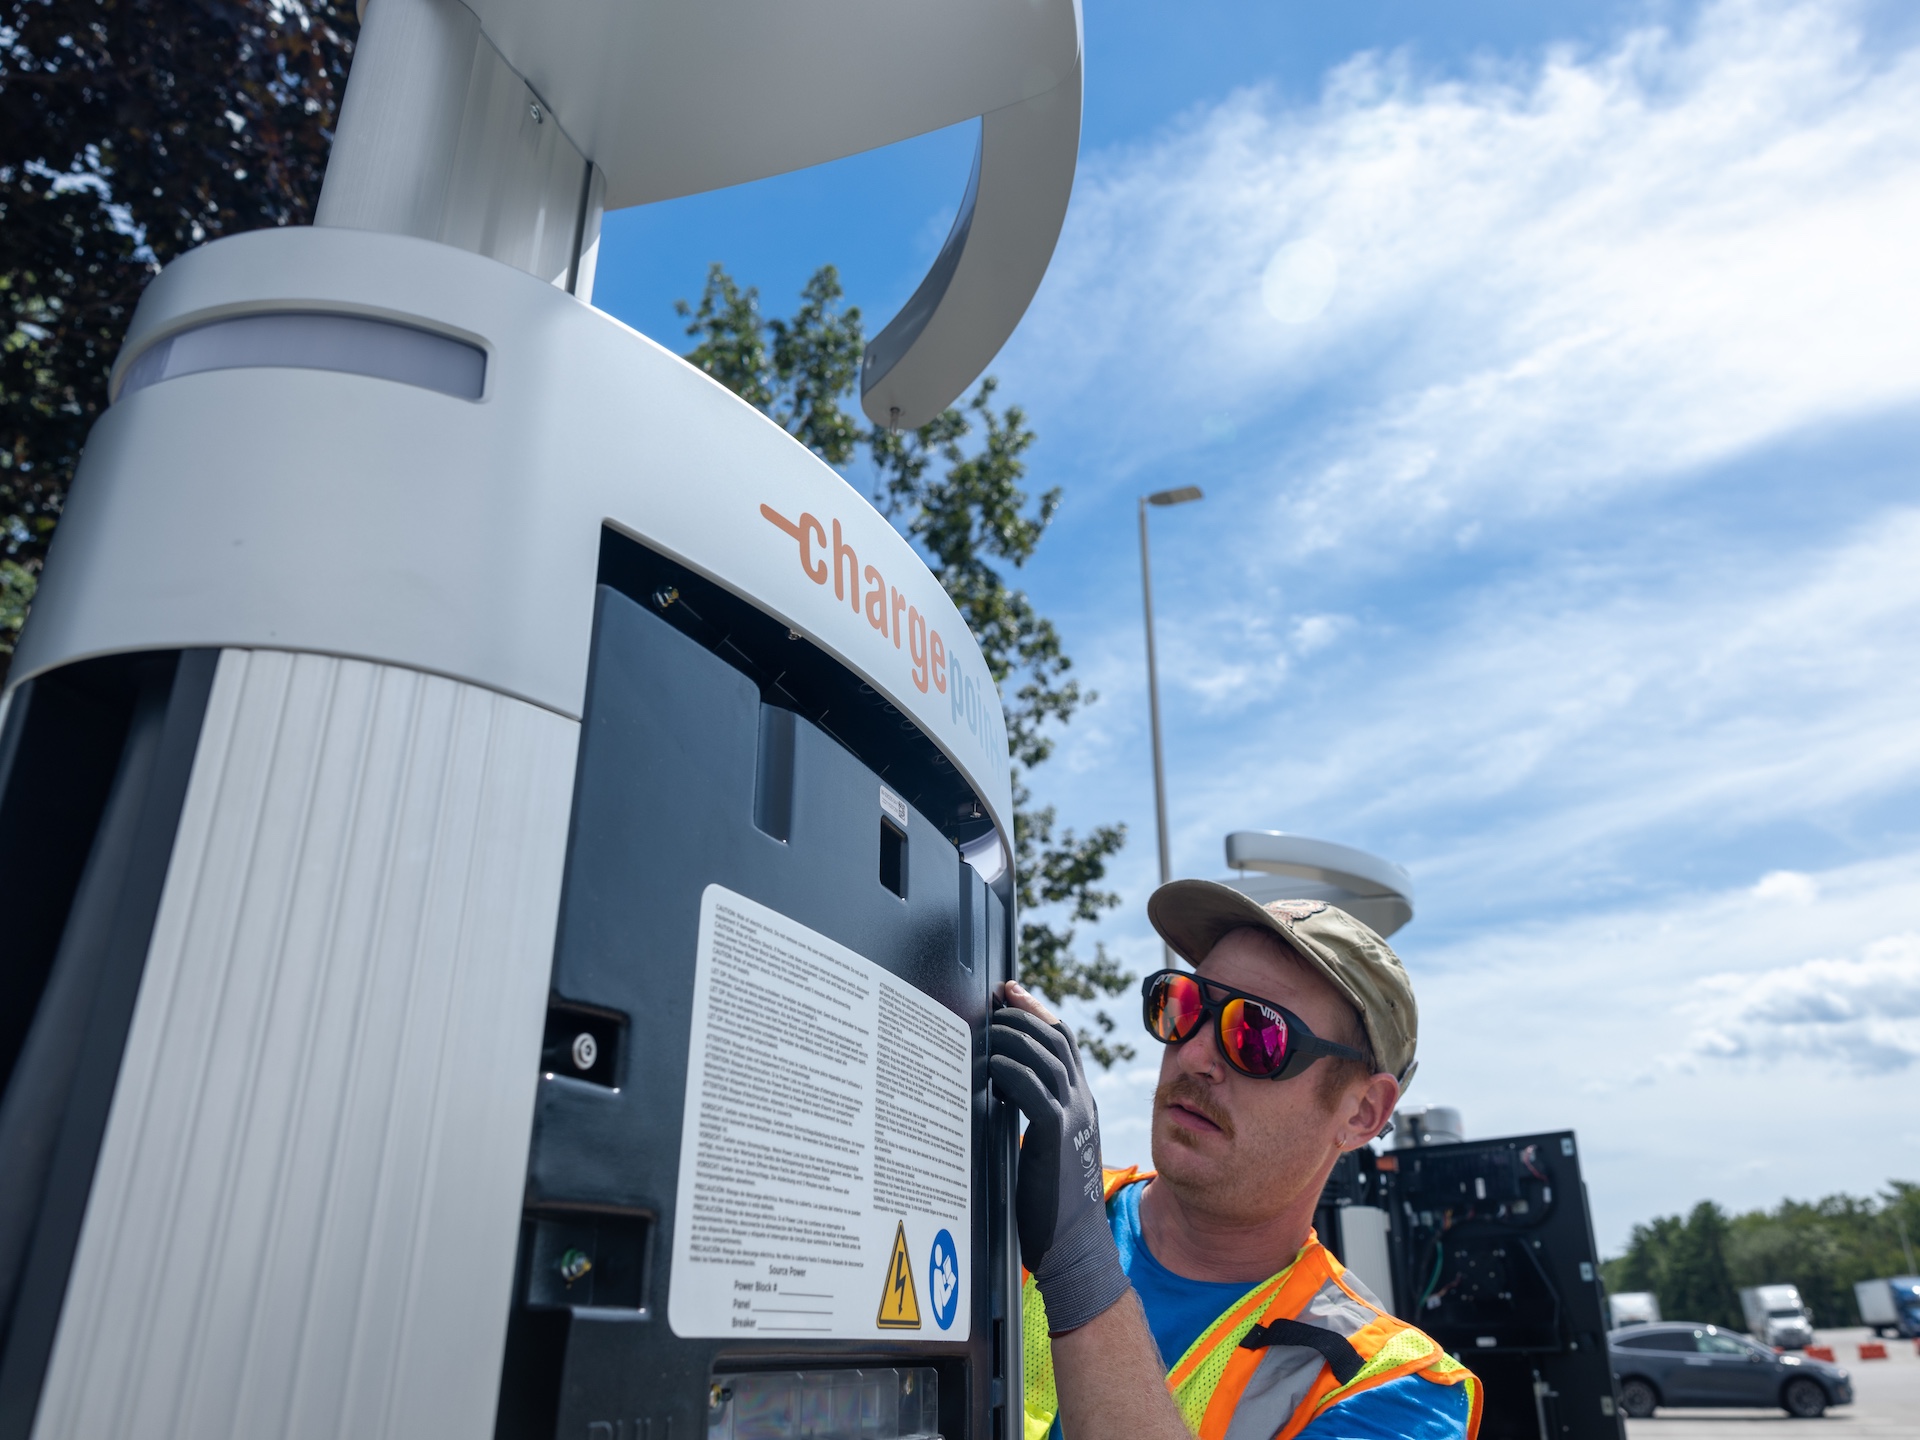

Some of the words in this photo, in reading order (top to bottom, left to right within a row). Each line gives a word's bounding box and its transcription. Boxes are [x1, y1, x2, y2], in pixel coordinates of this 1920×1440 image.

[760, 504, 1002, 781] chargepoint
[1253, 1001, 1286, 1037] VIPER
[769, 1264, 788, 1275] Source
[790, 1266, 806, 1277] Power
[734, 1280, 754, 1291] Power
[755, 1281, 772, 1292] Block
[733, 1298, 750, 1309] Panel
[732, 1316, 756, 1328] Breaker
